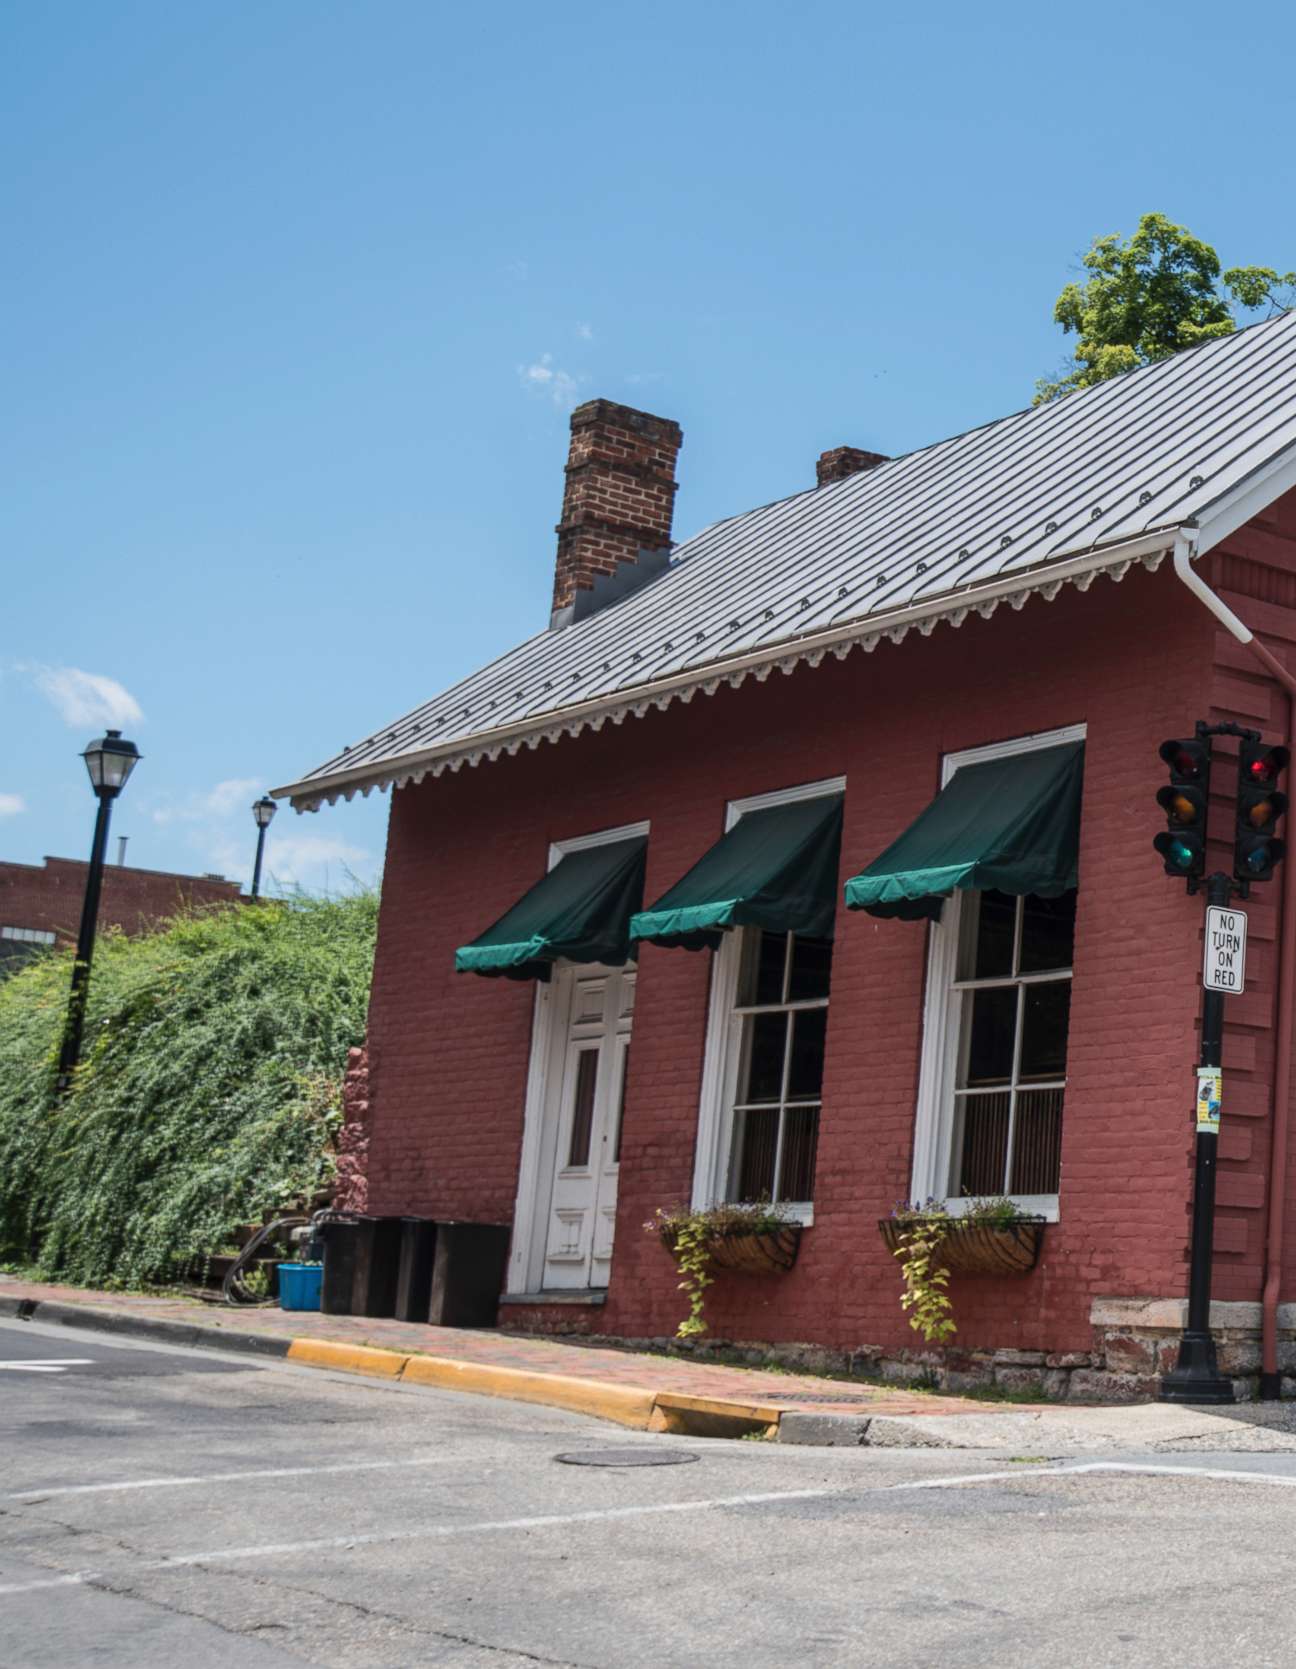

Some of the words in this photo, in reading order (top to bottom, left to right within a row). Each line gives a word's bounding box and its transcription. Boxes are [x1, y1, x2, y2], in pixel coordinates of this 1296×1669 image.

[1220, 914, 1235, 931] NO
[1212, 931, 1240, 952] TURN
[1218, 951, 1233, 968] ON
[1214, 969, 1235, 986] RED
